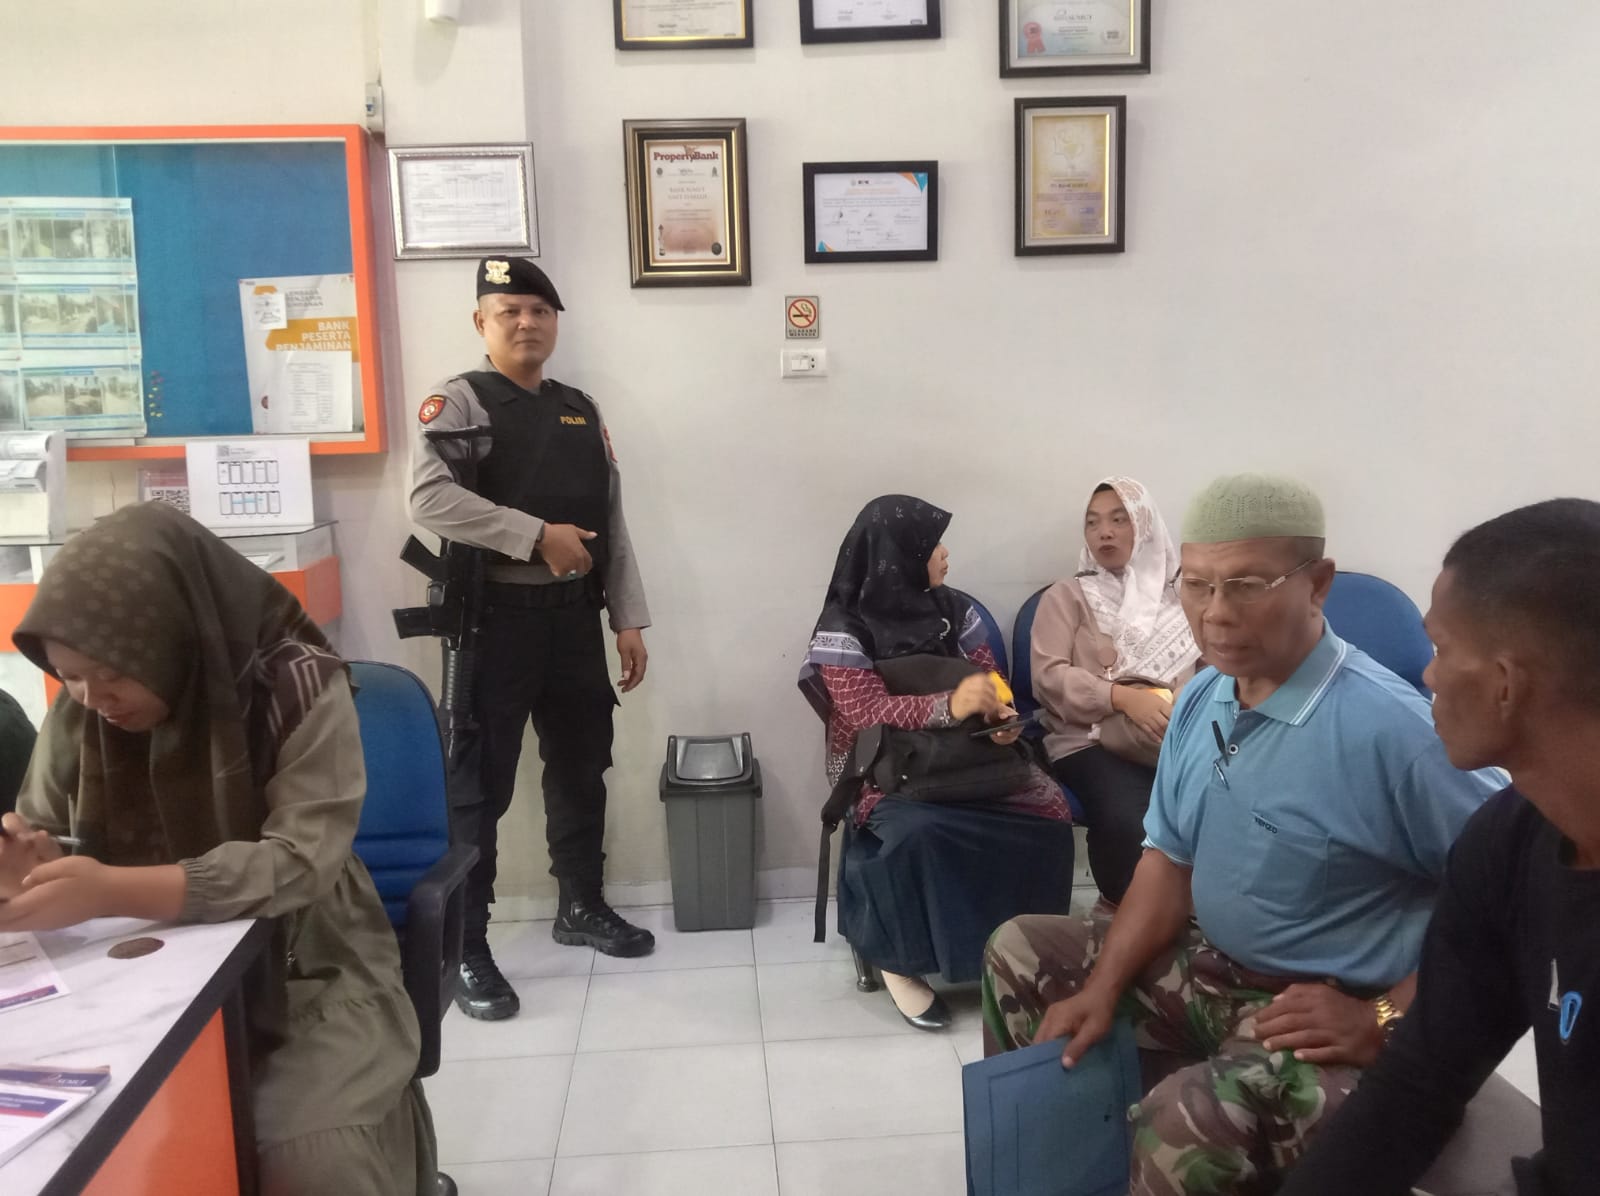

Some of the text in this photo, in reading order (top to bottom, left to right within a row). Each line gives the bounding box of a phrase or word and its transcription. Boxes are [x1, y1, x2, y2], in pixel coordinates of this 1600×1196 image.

[653, 151, 719, 163] PropertyBank
[318, 320, 350, 331] BANK
[301, 331, 351, 342] PESERTA
[559, 415, 587, 425] POLISI
